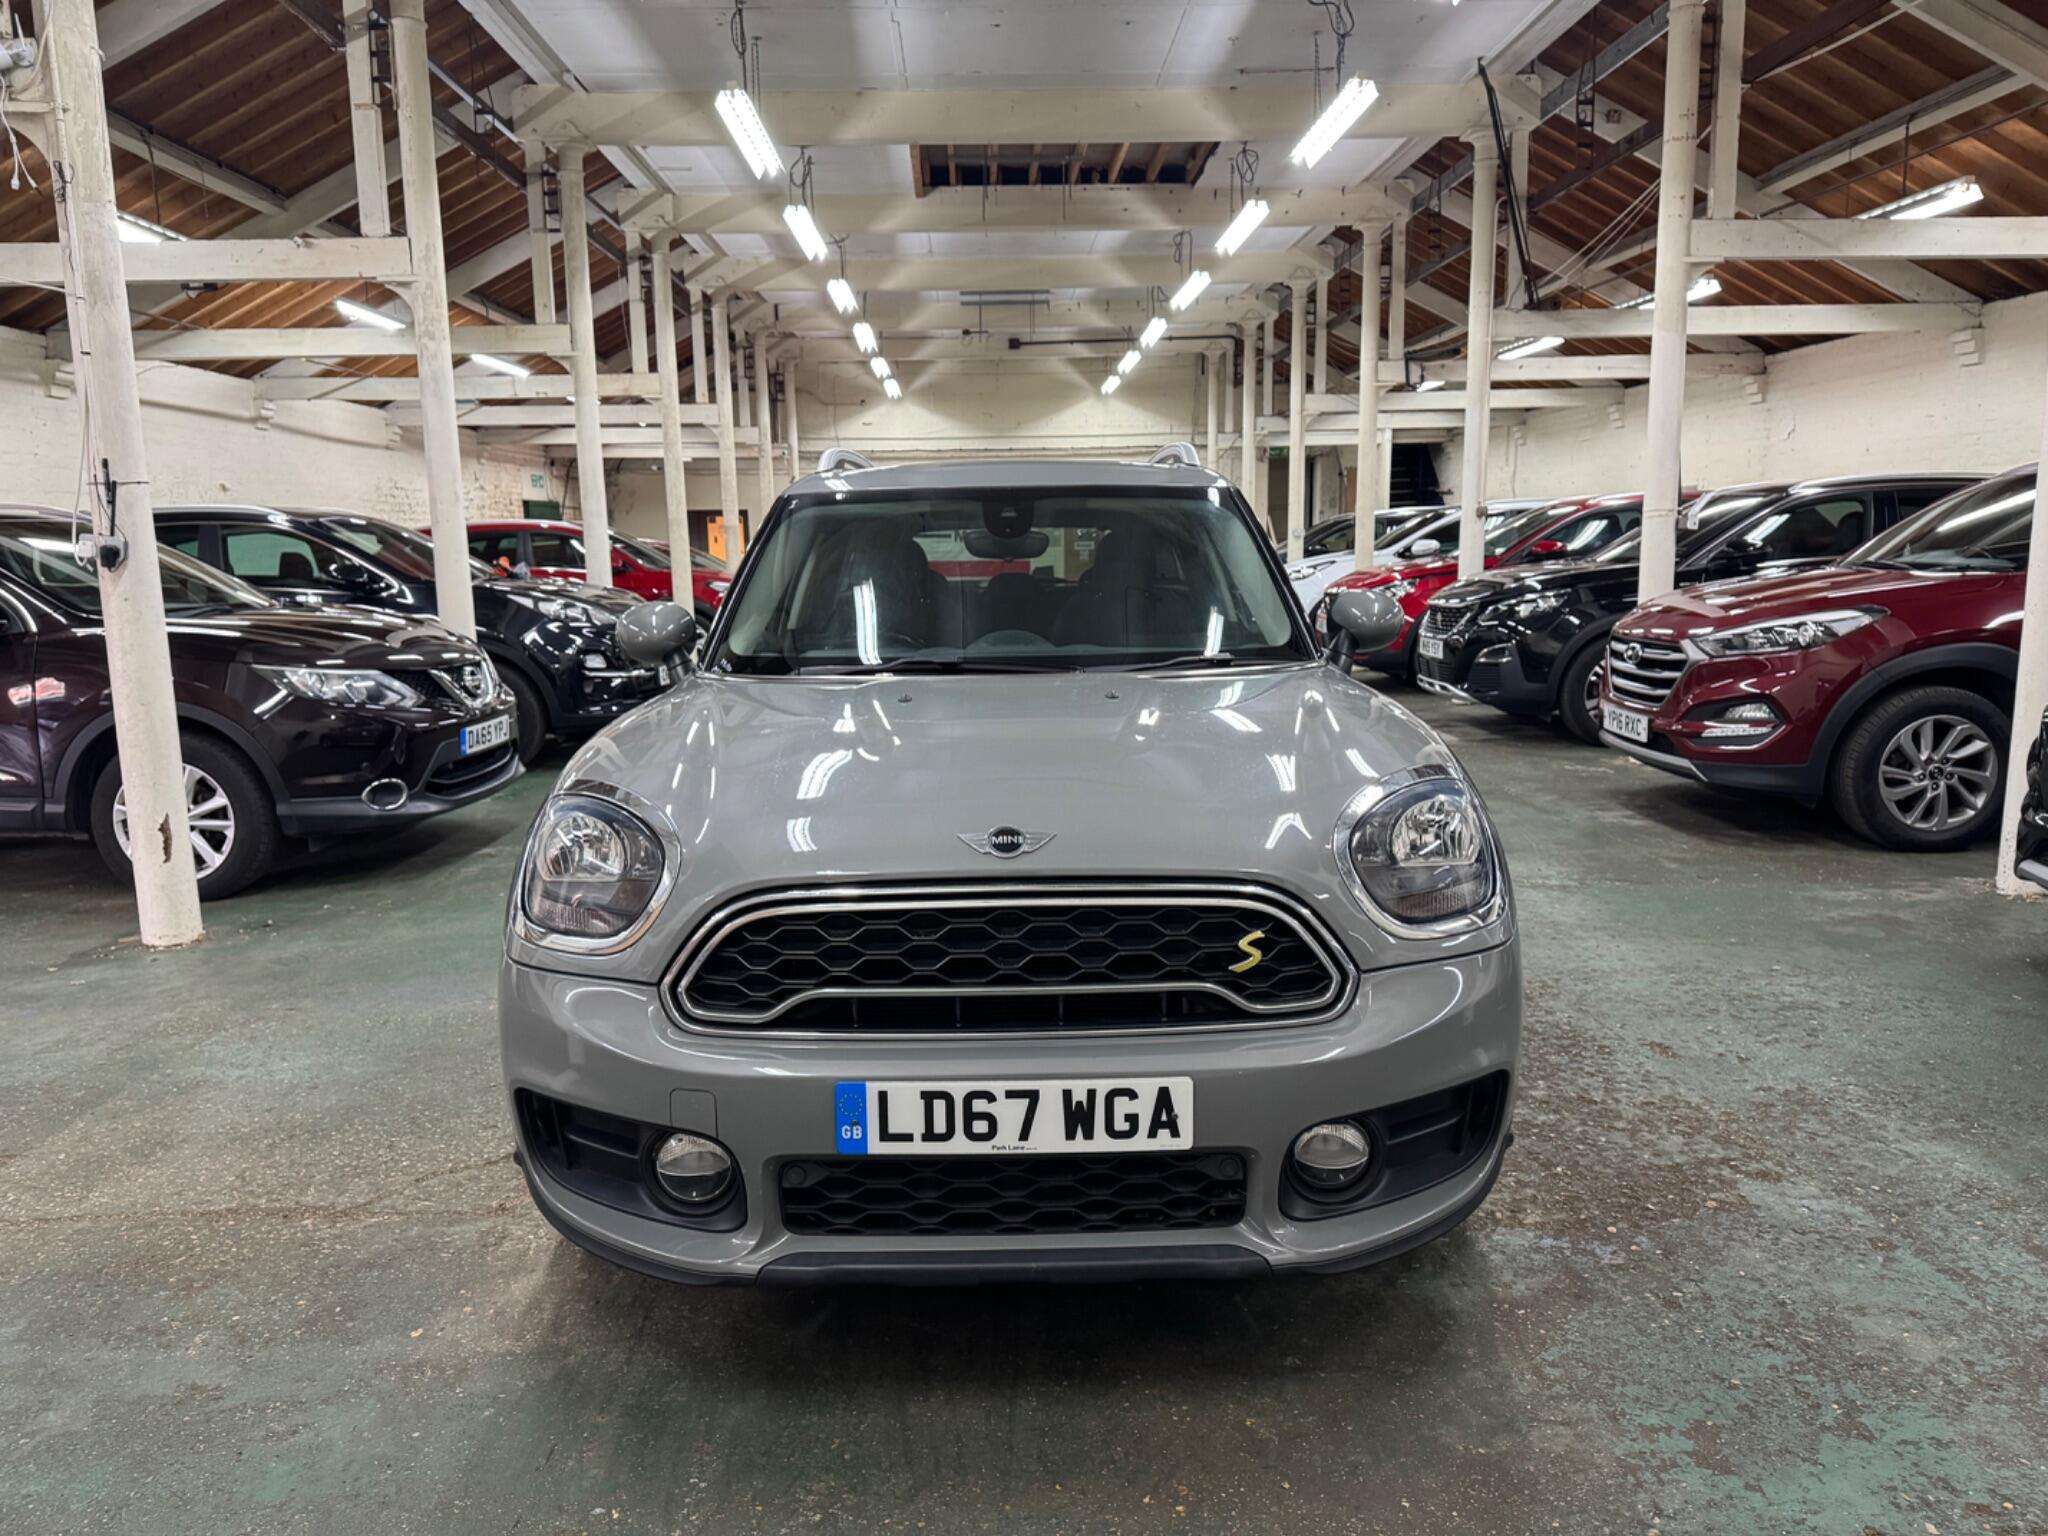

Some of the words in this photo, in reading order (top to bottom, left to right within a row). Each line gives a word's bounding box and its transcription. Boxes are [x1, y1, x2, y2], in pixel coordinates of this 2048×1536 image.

[468, 723, 493, 750] DA65
[494, 717, 509, 741] YPJ
[1607, 707, 1624, 732] YP16
[1624, 713, 1642, 737] RXC
[991, 834, 1024, 845] MINI
[1228, 930, 1266, 974] S
[877, 1088, 1041, 1143] LD67
[1061, 1085, 1181, 1141] WGA
[841, 1124, 863, 1140] GB
